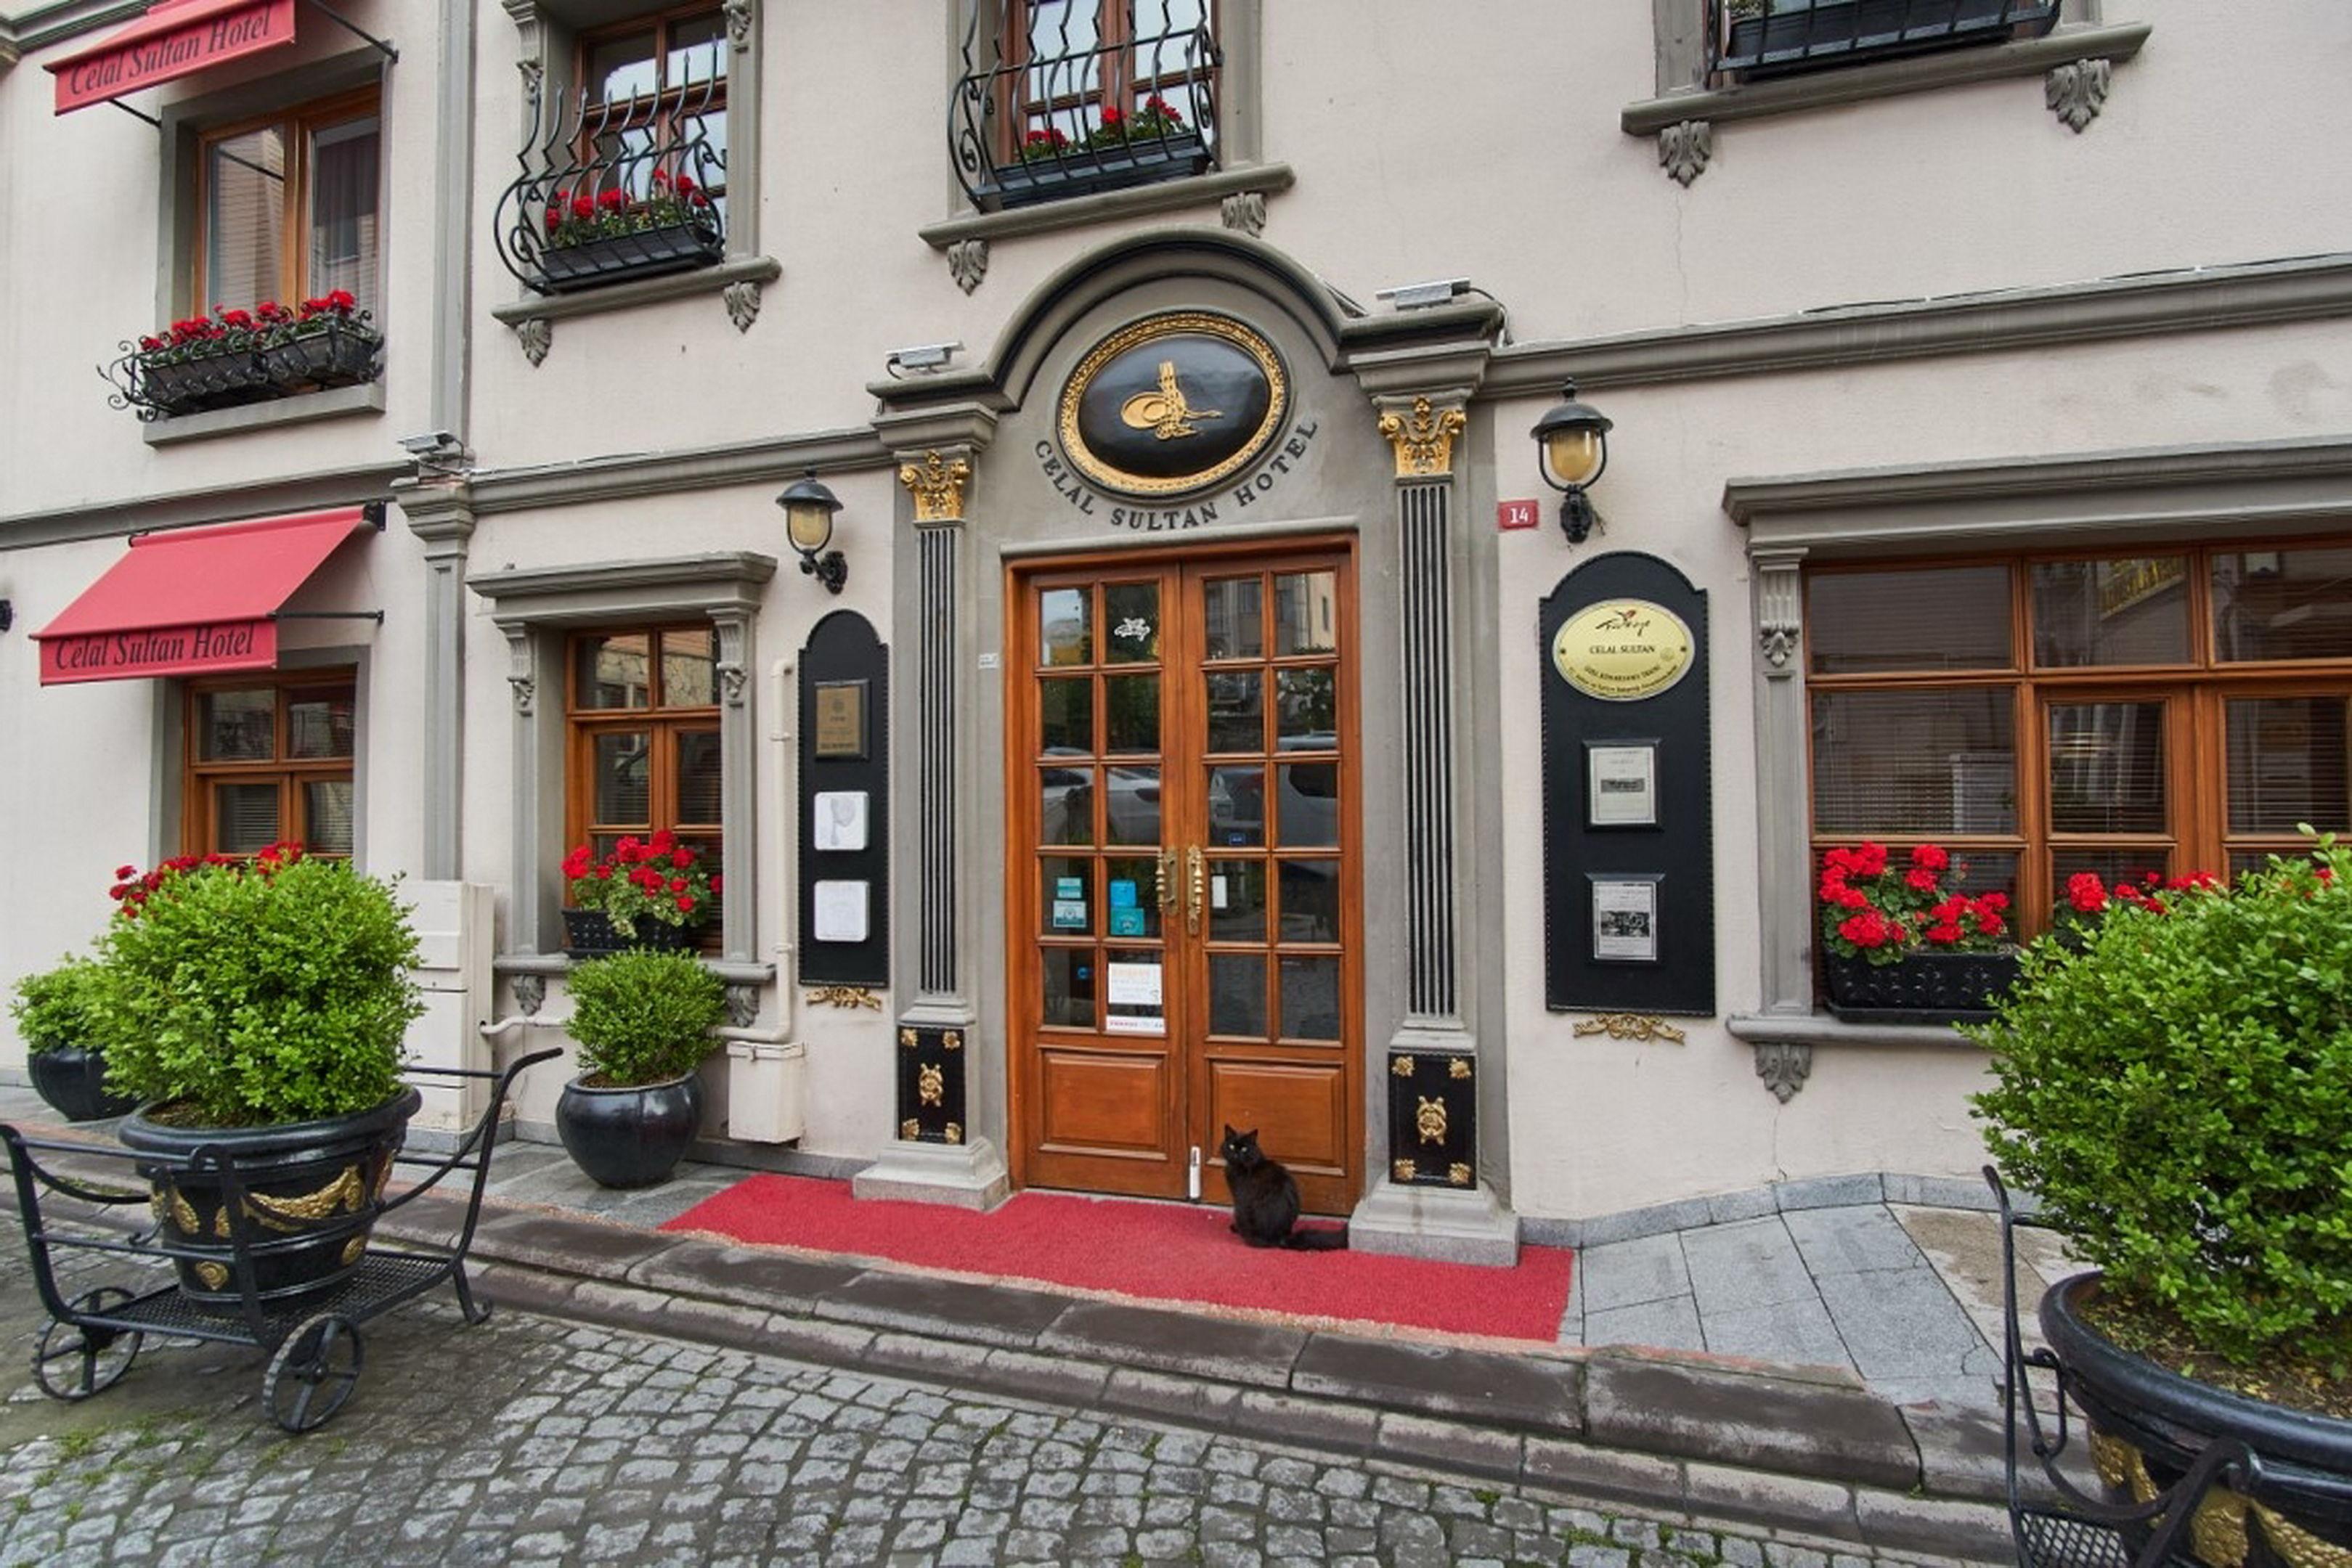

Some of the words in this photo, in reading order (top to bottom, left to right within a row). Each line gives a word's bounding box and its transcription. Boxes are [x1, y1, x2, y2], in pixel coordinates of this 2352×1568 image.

[69, 54, 124, 95] Celal
[127, 36, 200, 78] Sultan
[207, 4, 271, 54] Hotel
[1035, 439, 1094, 516] CELAL
[1110, 501, 1218, 531] SULTAN
[1234, 419, 1318, 507] HOTEL
[1510, 507, 1529, 523] 14
[55, 633, 110, 670] Celal
[113, 630, 185, 666] Sultan
[192, 621, 255, 660] Hotel
[1589, 645, 1616, 654] CELAL
[1620, 644, 1655, 654] SULTAN
